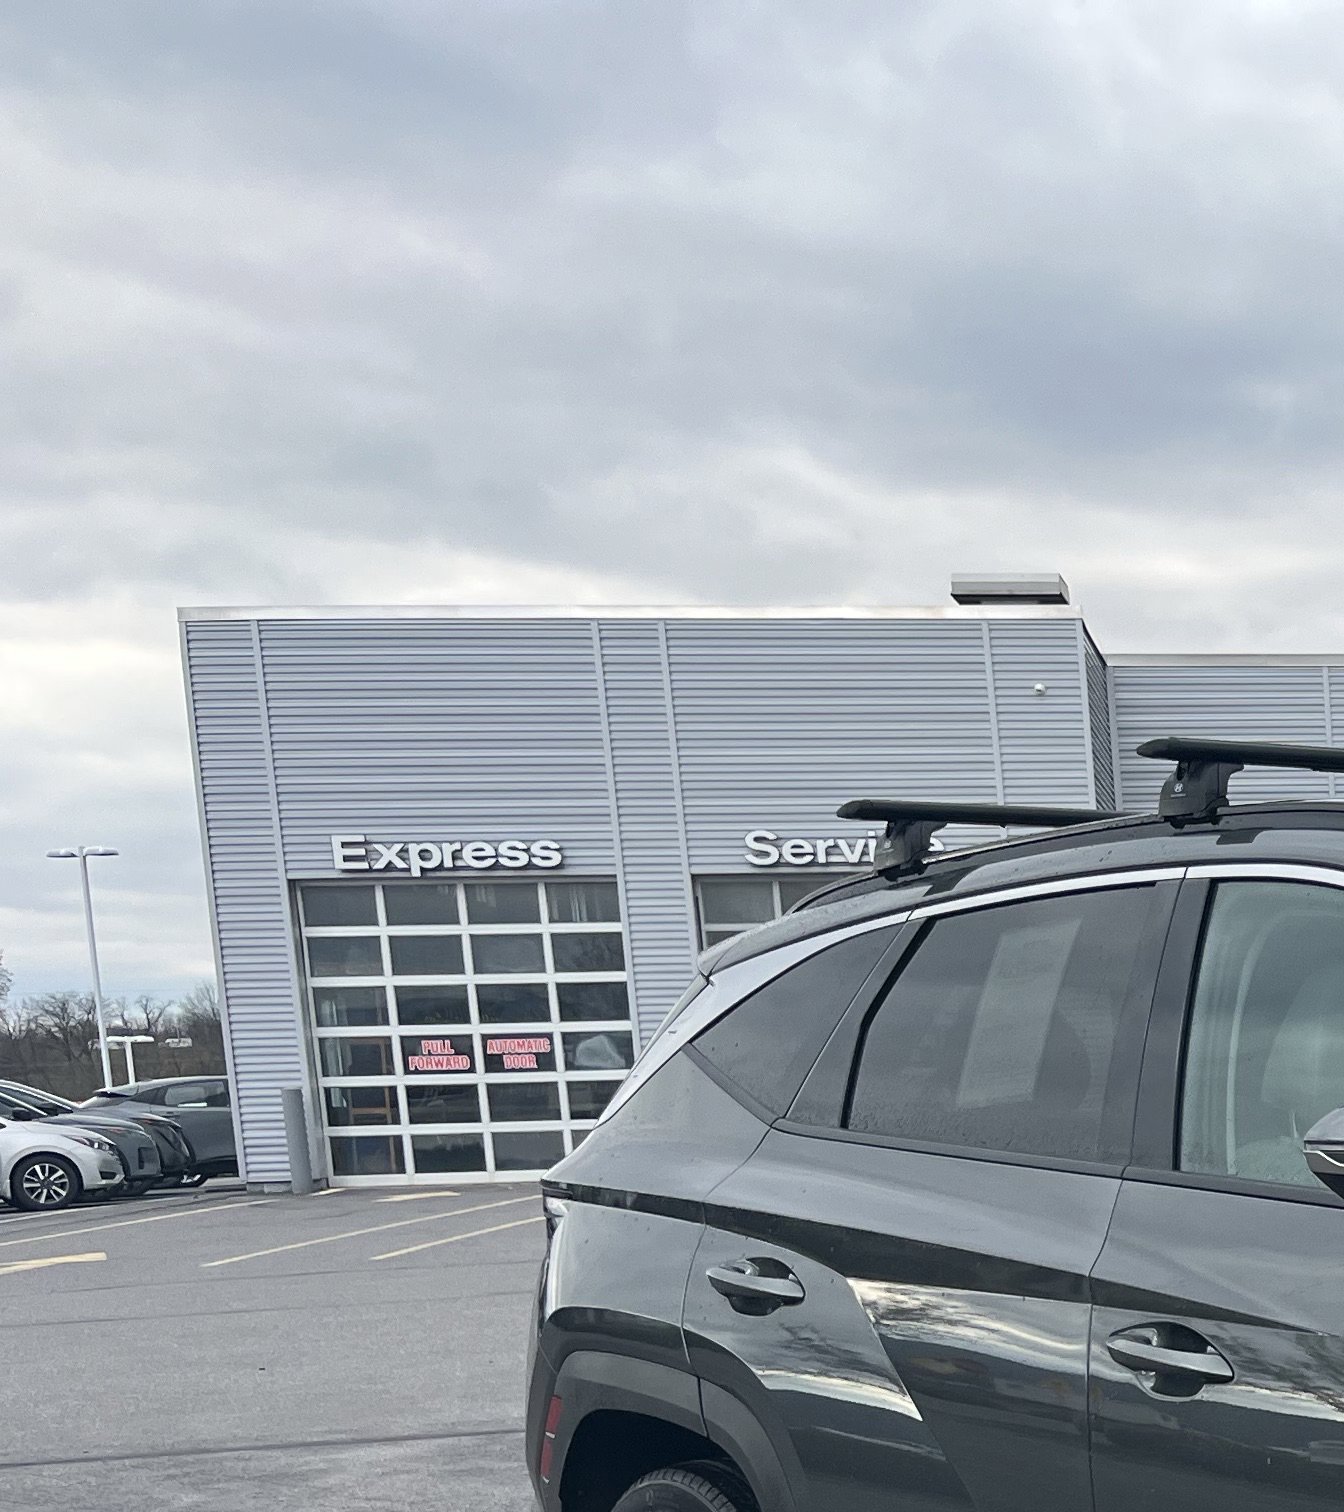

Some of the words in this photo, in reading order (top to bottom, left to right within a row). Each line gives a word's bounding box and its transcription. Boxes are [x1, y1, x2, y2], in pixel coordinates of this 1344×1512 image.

[330, 834, 563, 878] Express
[744, 829, 945, 867] Servi
[420, 1039, 455, 1055] PULL
[486, 1037, 551, 1055] AUTOMATIC
[408, 1054, 471, 1071] FORWARD
[503, 1053, 538, 1070] DOOR
